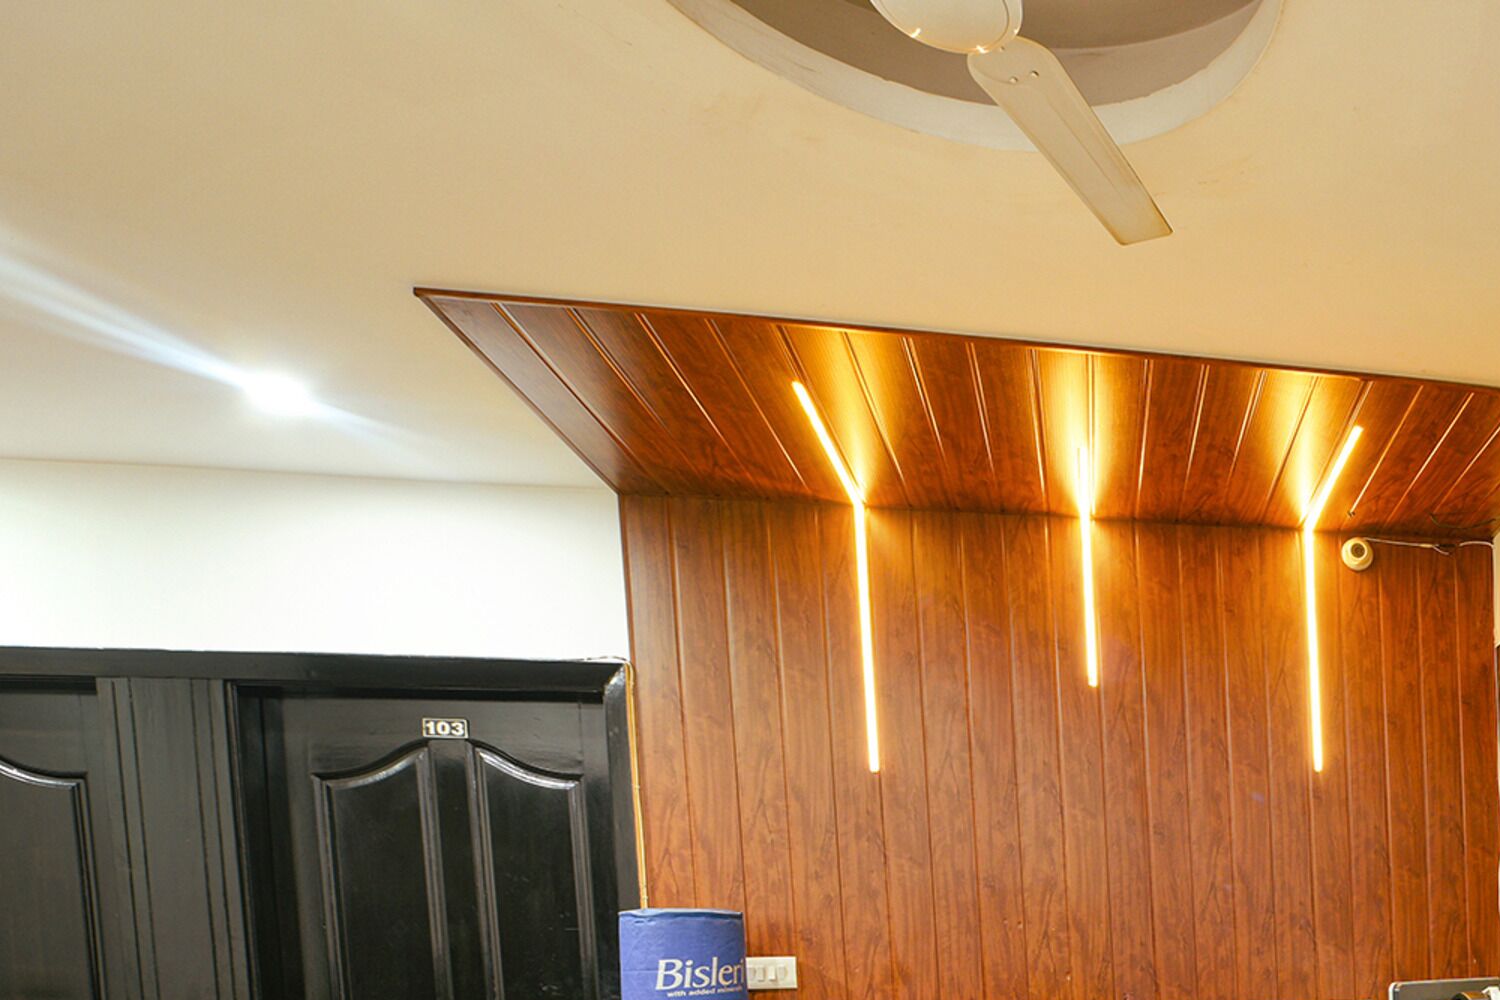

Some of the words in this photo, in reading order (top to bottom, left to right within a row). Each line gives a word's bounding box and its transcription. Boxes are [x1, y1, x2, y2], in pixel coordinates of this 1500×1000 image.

[425, 720, 465, 736] 103
[667, 990, 686, 998] with
[688, 986, 716, 996] added
